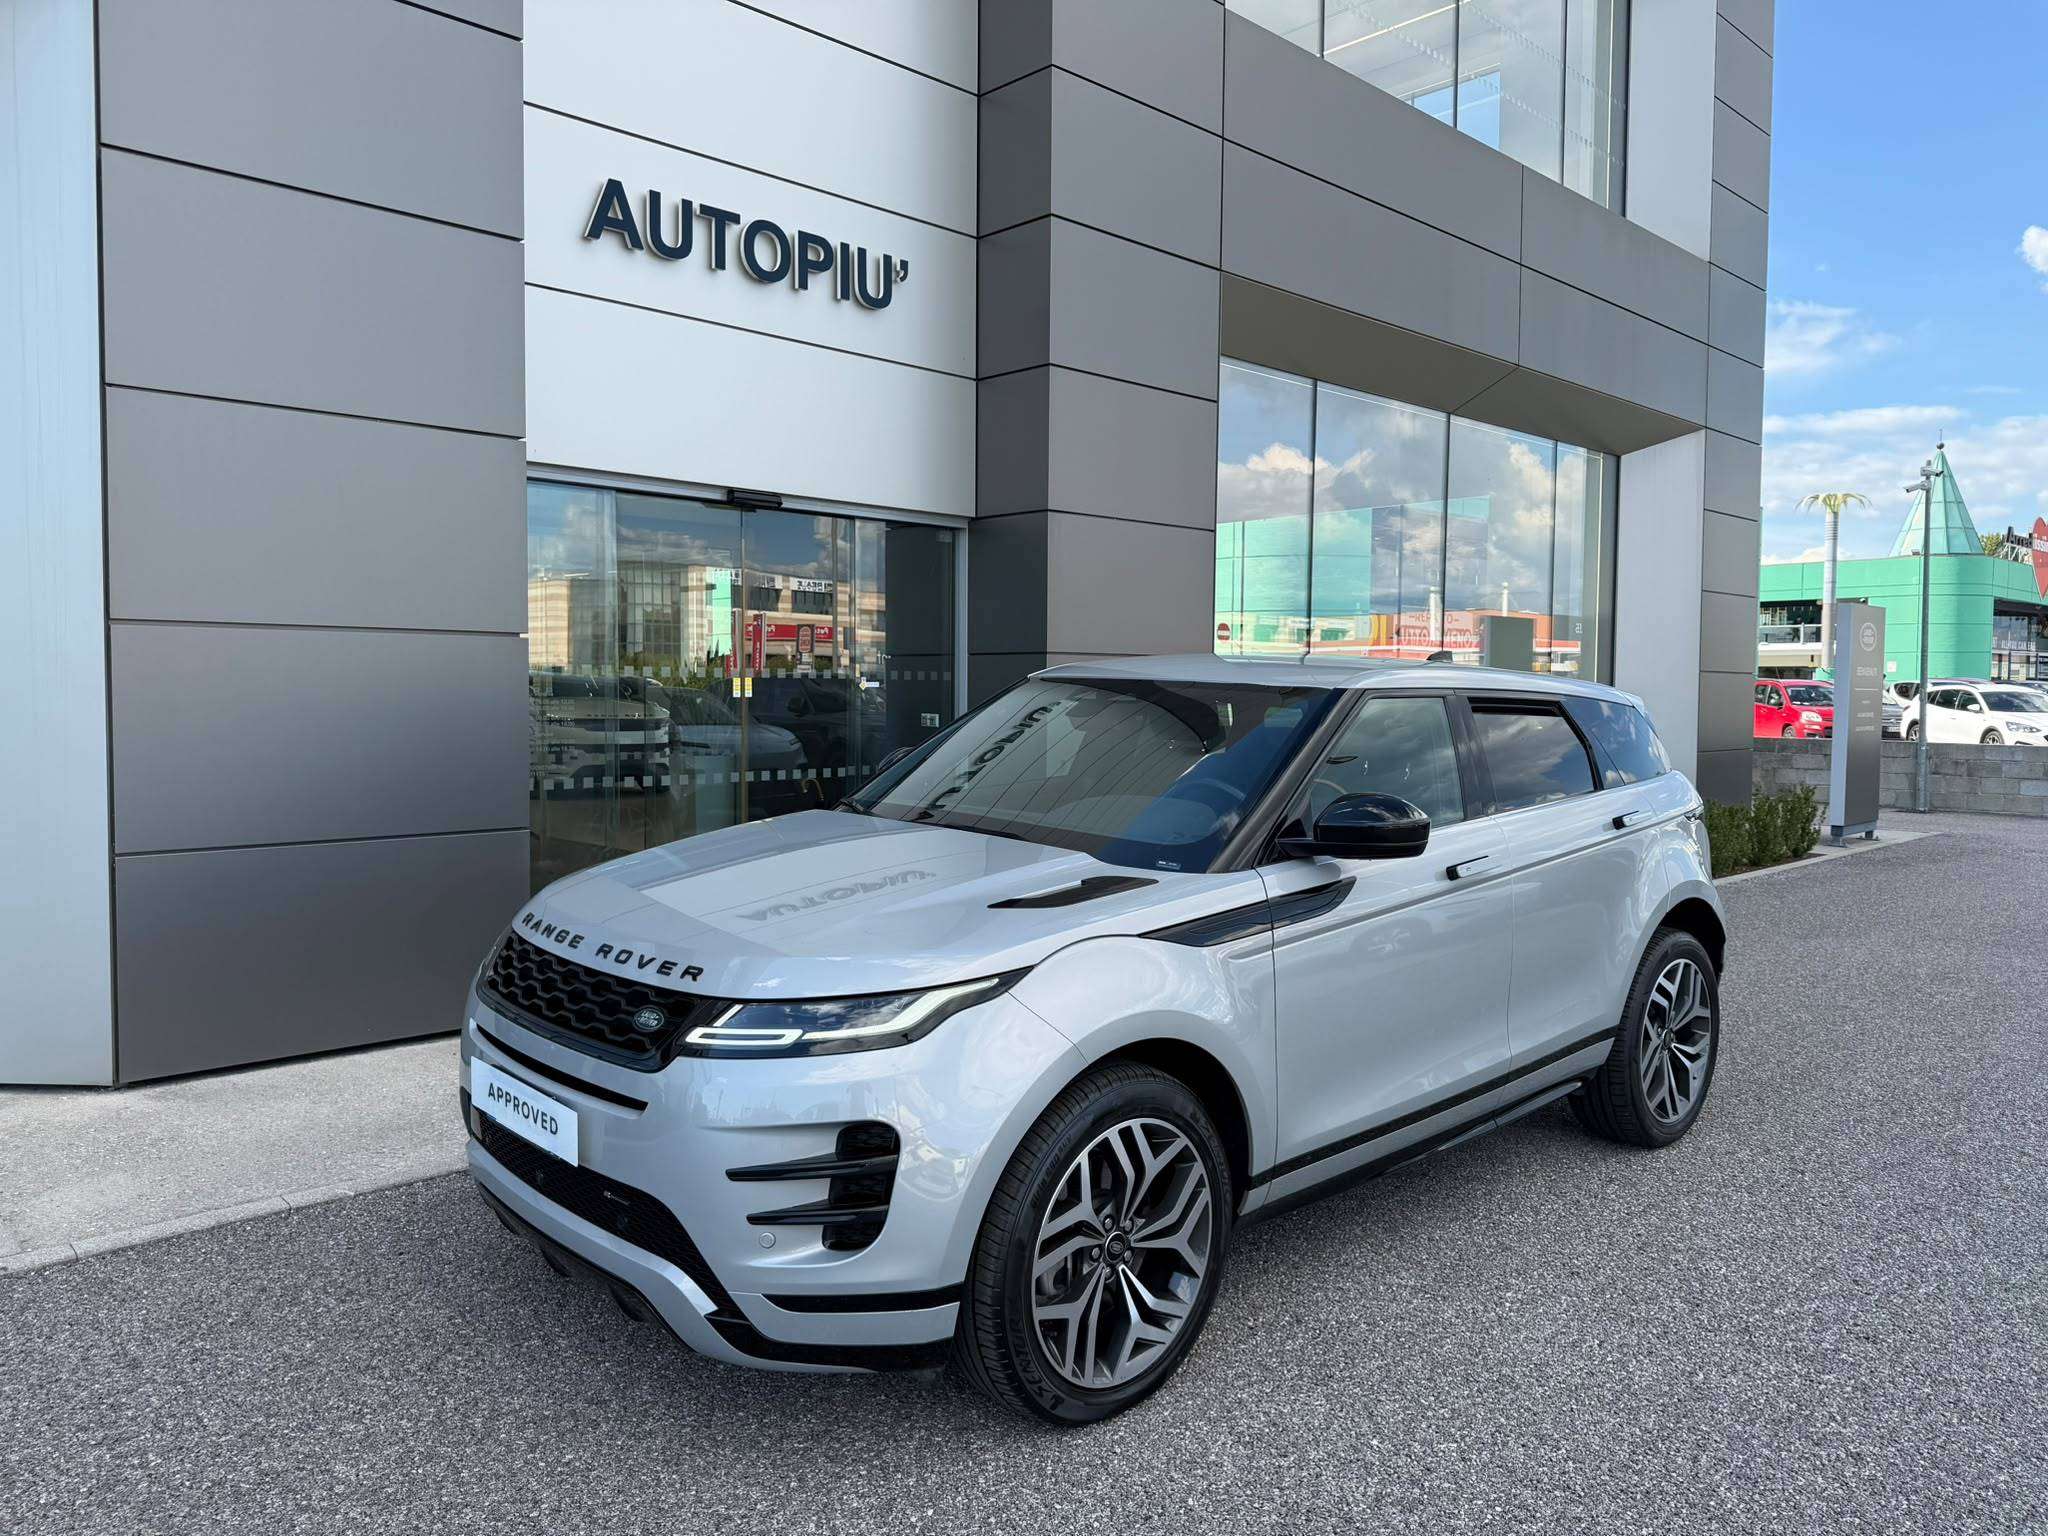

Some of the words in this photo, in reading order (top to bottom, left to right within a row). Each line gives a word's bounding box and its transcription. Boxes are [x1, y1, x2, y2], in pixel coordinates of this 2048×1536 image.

[585, 177, 909, 311] AUTOPIU'
[521, 911, 585, 949] RANGE
[595, 943, 704, 982] ROVER
[488, 1082, 559, 1135] APPROVED
